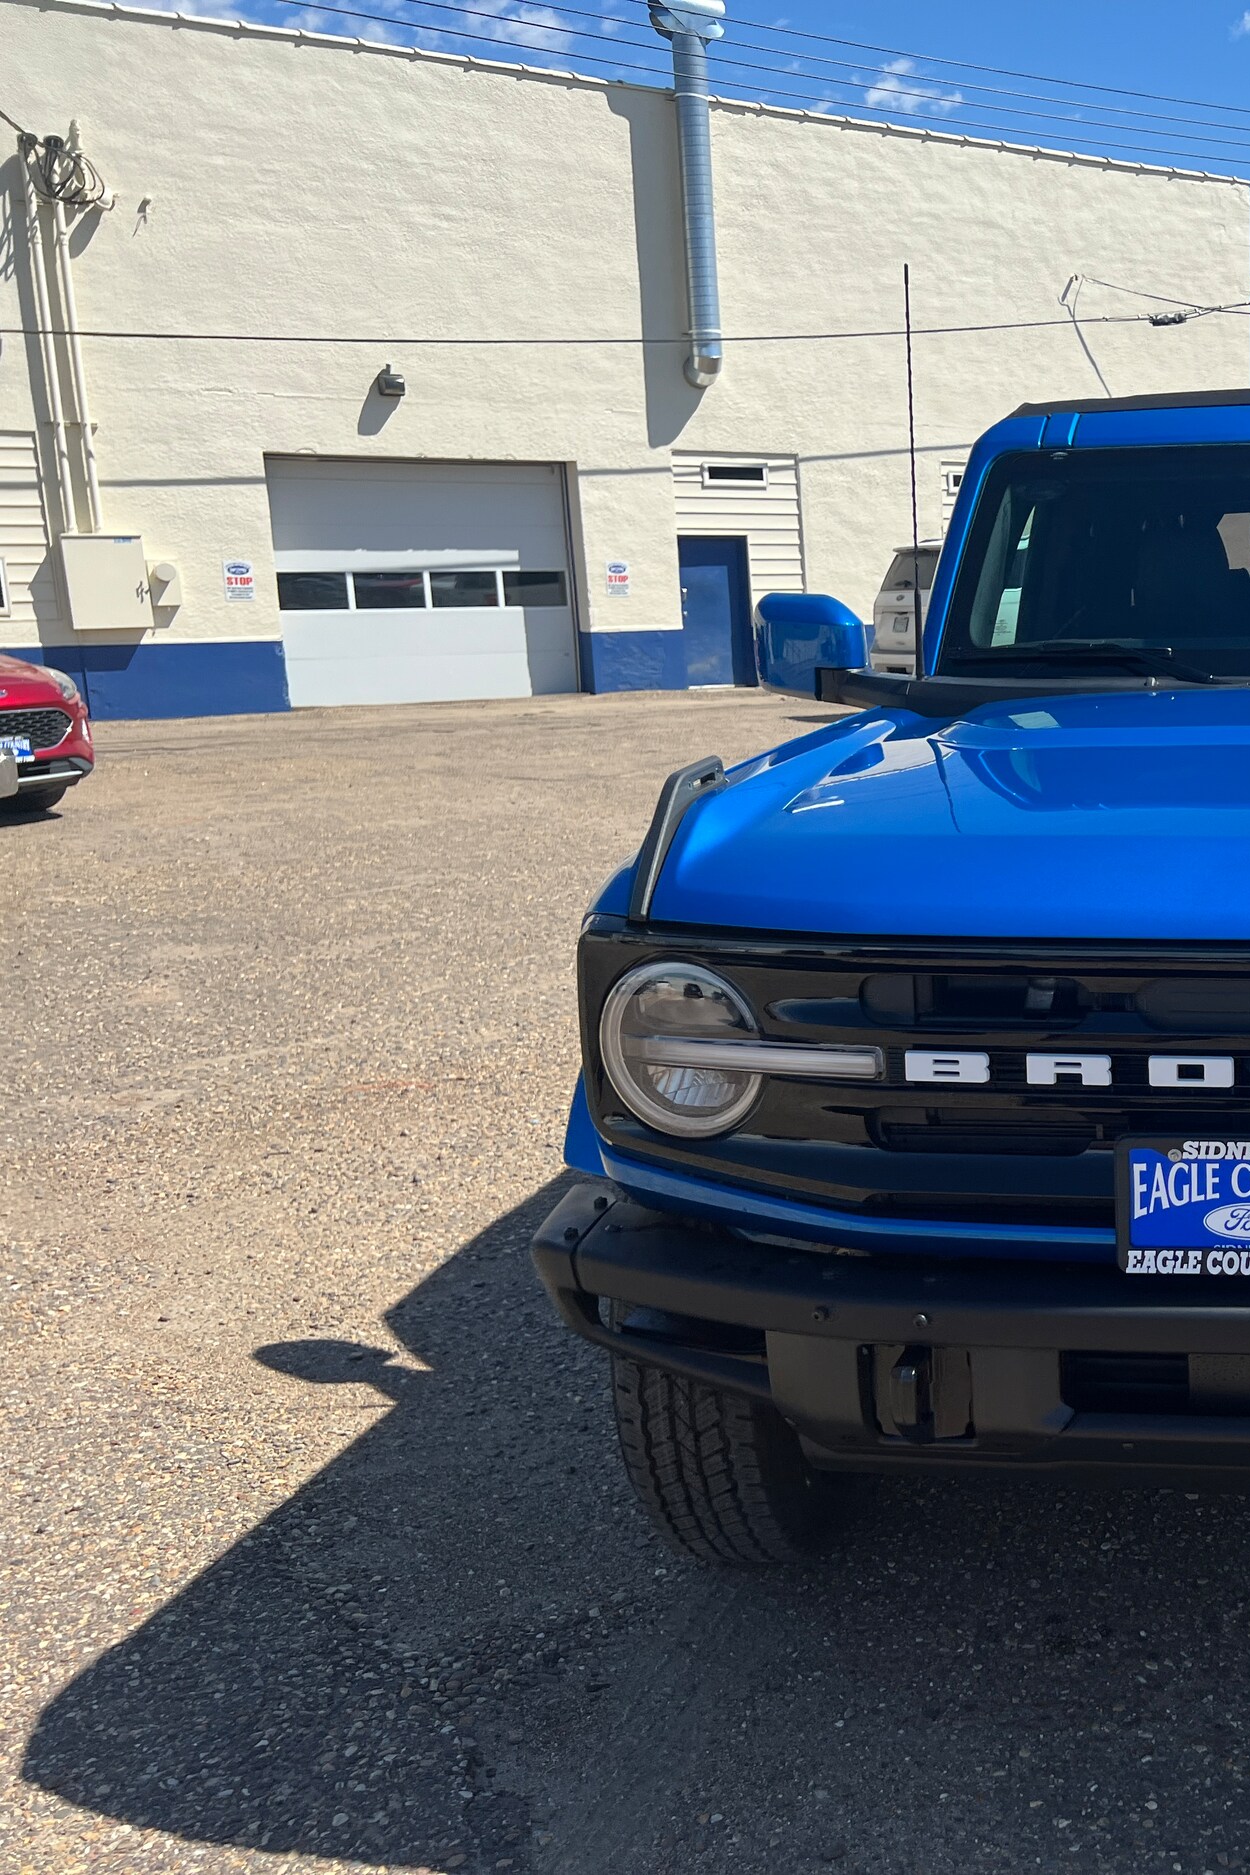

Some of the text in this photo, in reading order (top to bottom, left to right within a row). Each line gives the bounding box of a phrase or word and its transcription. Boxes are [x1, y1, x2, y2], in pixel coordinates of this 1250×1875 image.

[226, 576, 253, 586] STOP
[1133, 1162, 1220, 1220] EAGLE
[1126, 1250, 1201, 1274] EAGLE
